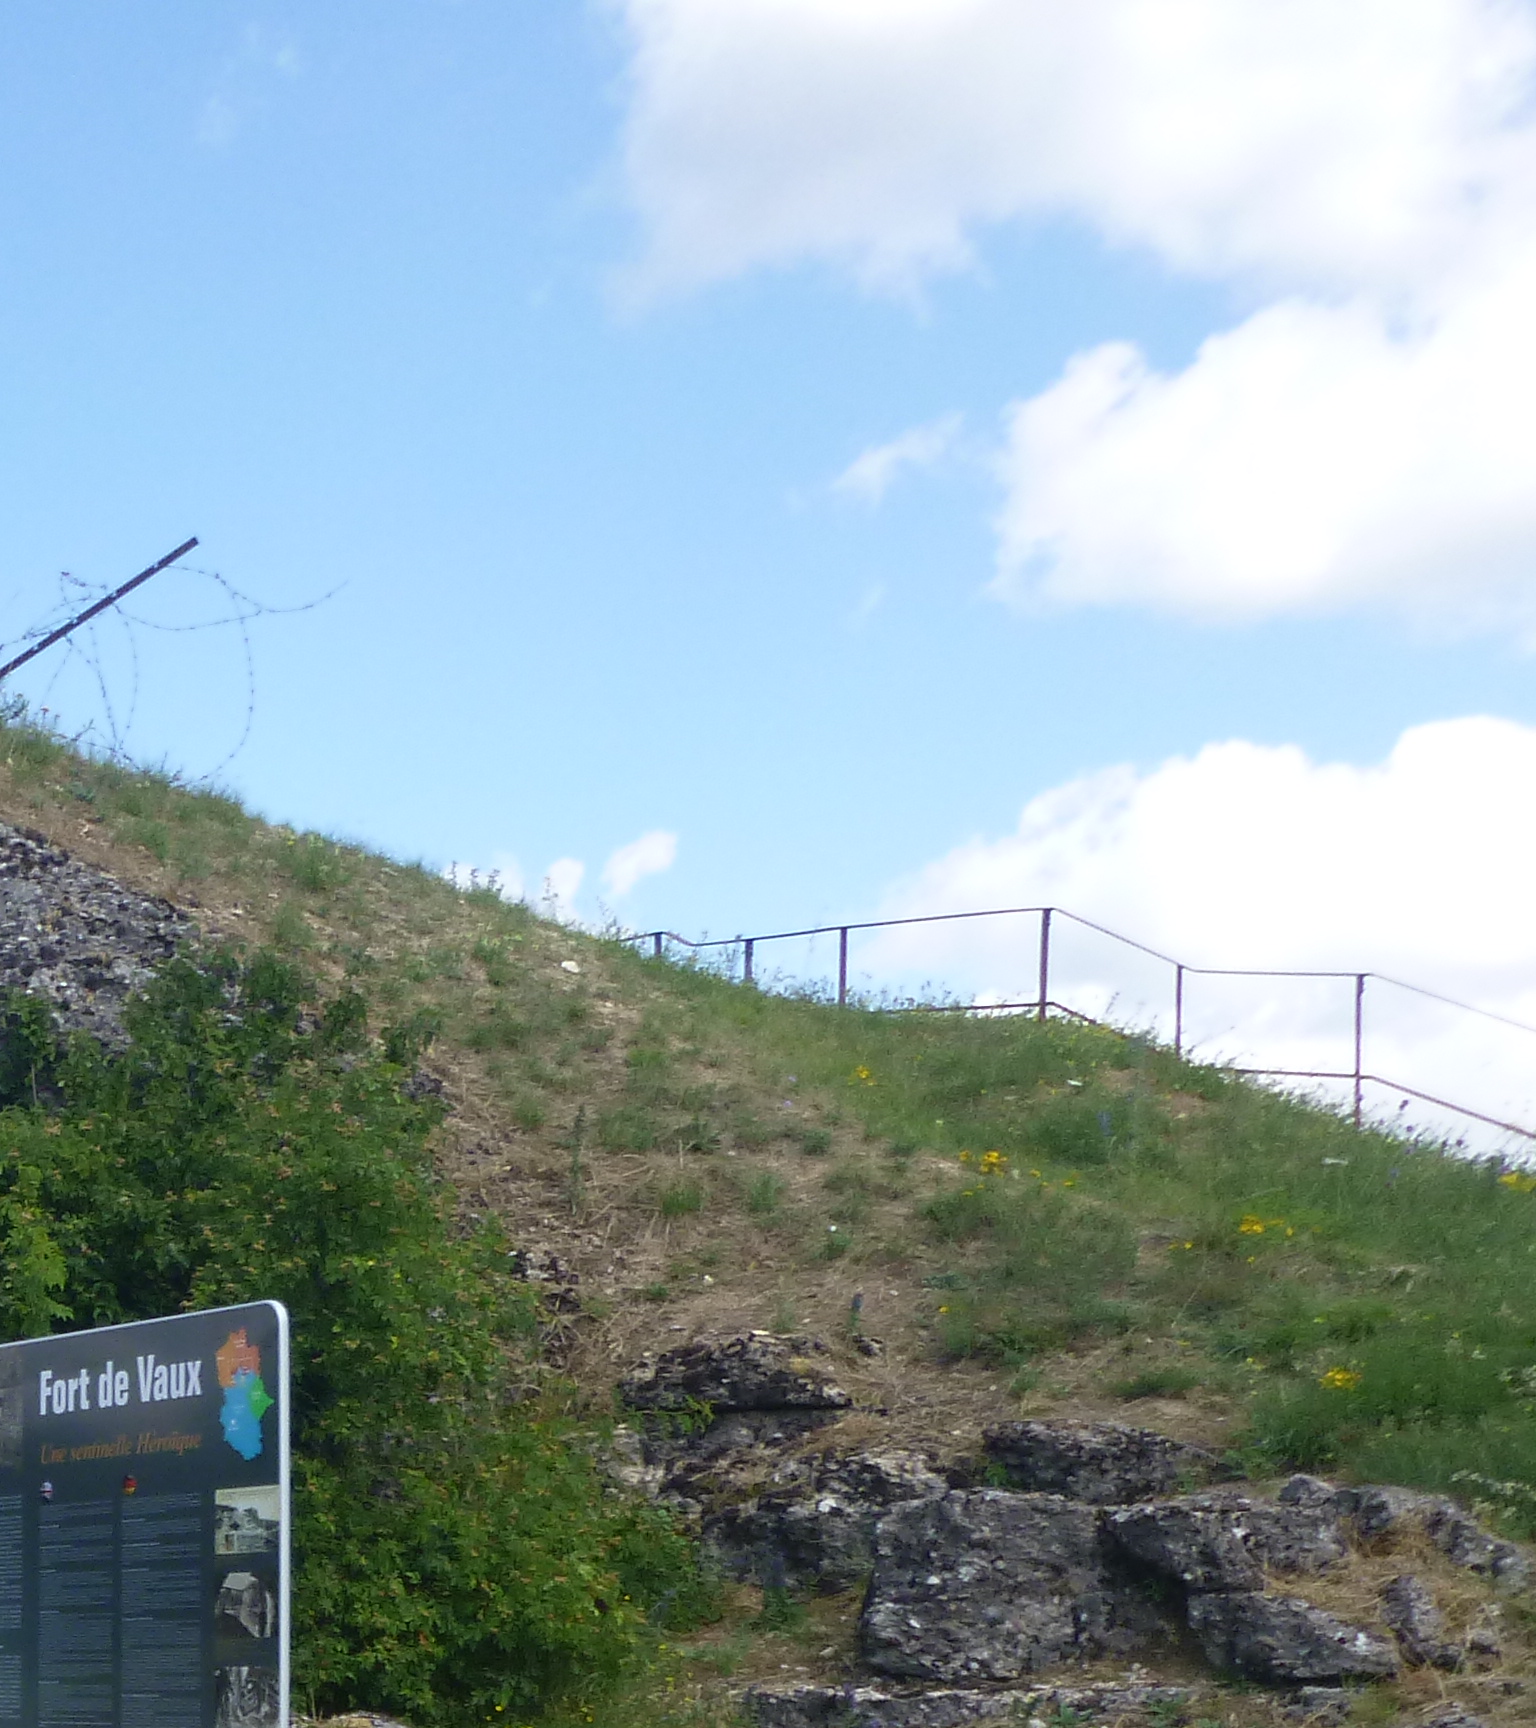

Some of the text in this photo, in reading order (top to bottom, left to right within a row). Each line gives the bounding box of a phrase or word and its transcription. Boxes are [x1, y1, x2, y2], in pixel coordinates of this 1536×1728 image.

[39, 1353, 202, 1416] Fort de Vaux
